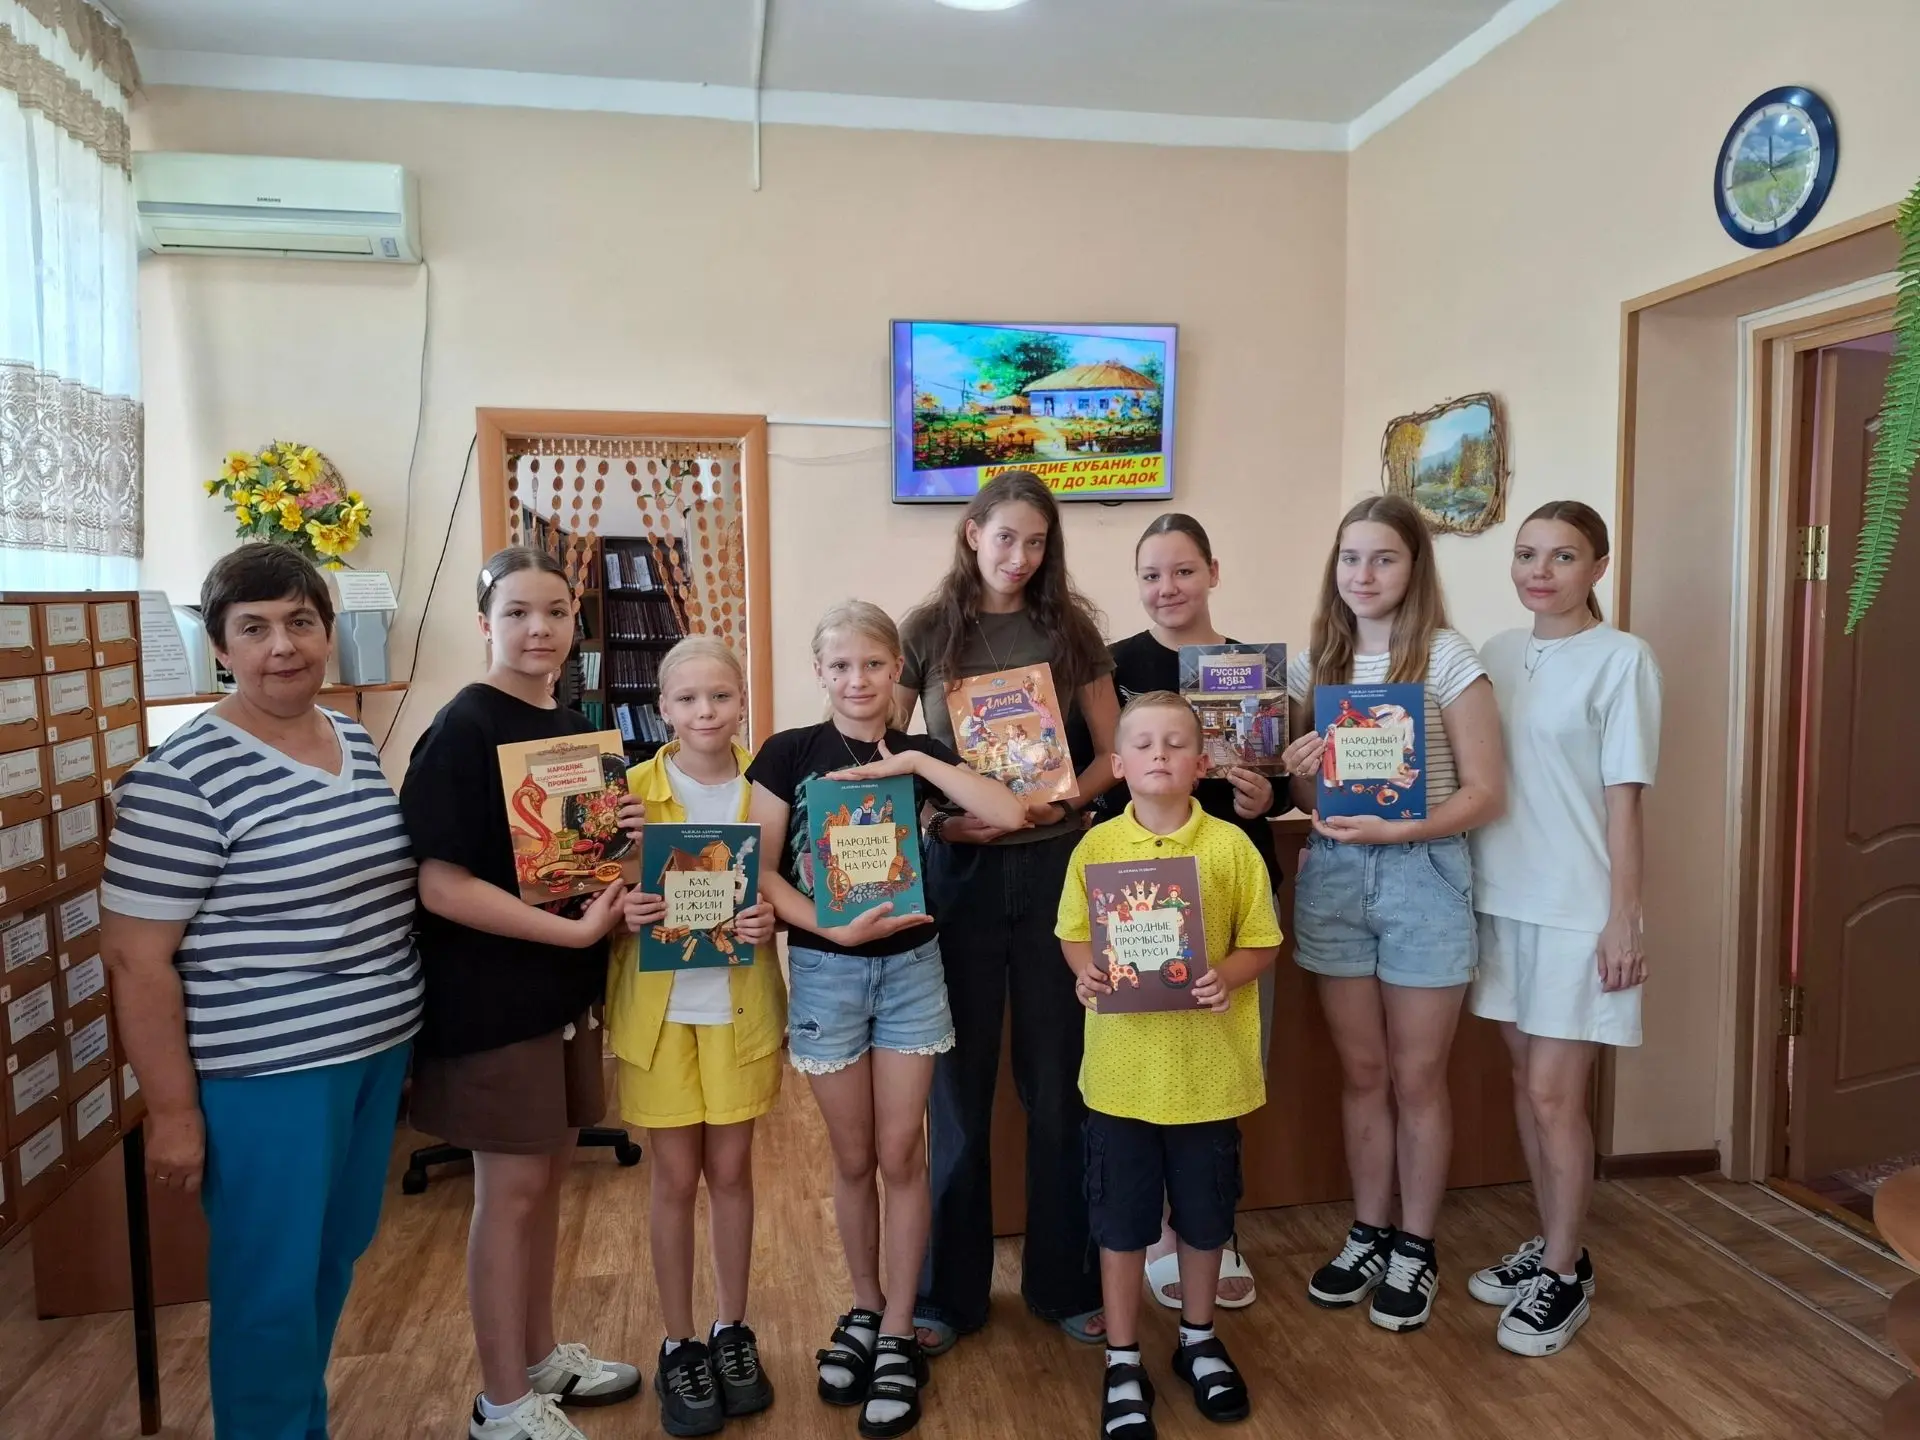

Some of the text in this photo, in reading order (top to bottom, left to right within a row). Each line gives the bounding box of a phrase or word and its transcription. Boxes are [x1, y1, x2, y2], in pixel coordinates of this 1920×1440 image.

[1072, 459, 1136, 472] КУБАНИ:
[1141, 456, 1161, 468] ОТ
[1062, 476, 1085, 490] ДО
[1090, 472, 1158, 486] ЗАГАДОК
[1341, 734, 1398, 745] НАРОДНЫЙ
[1345, 749, 1394, 758] КОСТЮМ
[547, 763, 584, 773] НАРОДНЫЕ
[1348, 761, 1392, 770] НА РУСИ
[547, 776, 588, 787] ПРОМЫСЛЫ
[837, 835, 890, 847] НАРОДНЫЕ
[842, 848, 888, 860] РЕМЕСЛА
[844, 860, 887, 871] НА РУСИ
[689, 877, 711, 887] КАК
[674, 889, 725, 899] СТРОИЛИ
[675, 901, 723, 911] И ЖИЛИ
[675, 913, 722, 923] НА РУСИ
[1115, 922, 1172, 934] НАРОДНЫЕ
[1114, 935, 1175, 946] ПРОМЫСЛЫ
[1123, 947, 1169, 959] НА РУСИ
[1405, 1240, 1426, 1252] adidas
